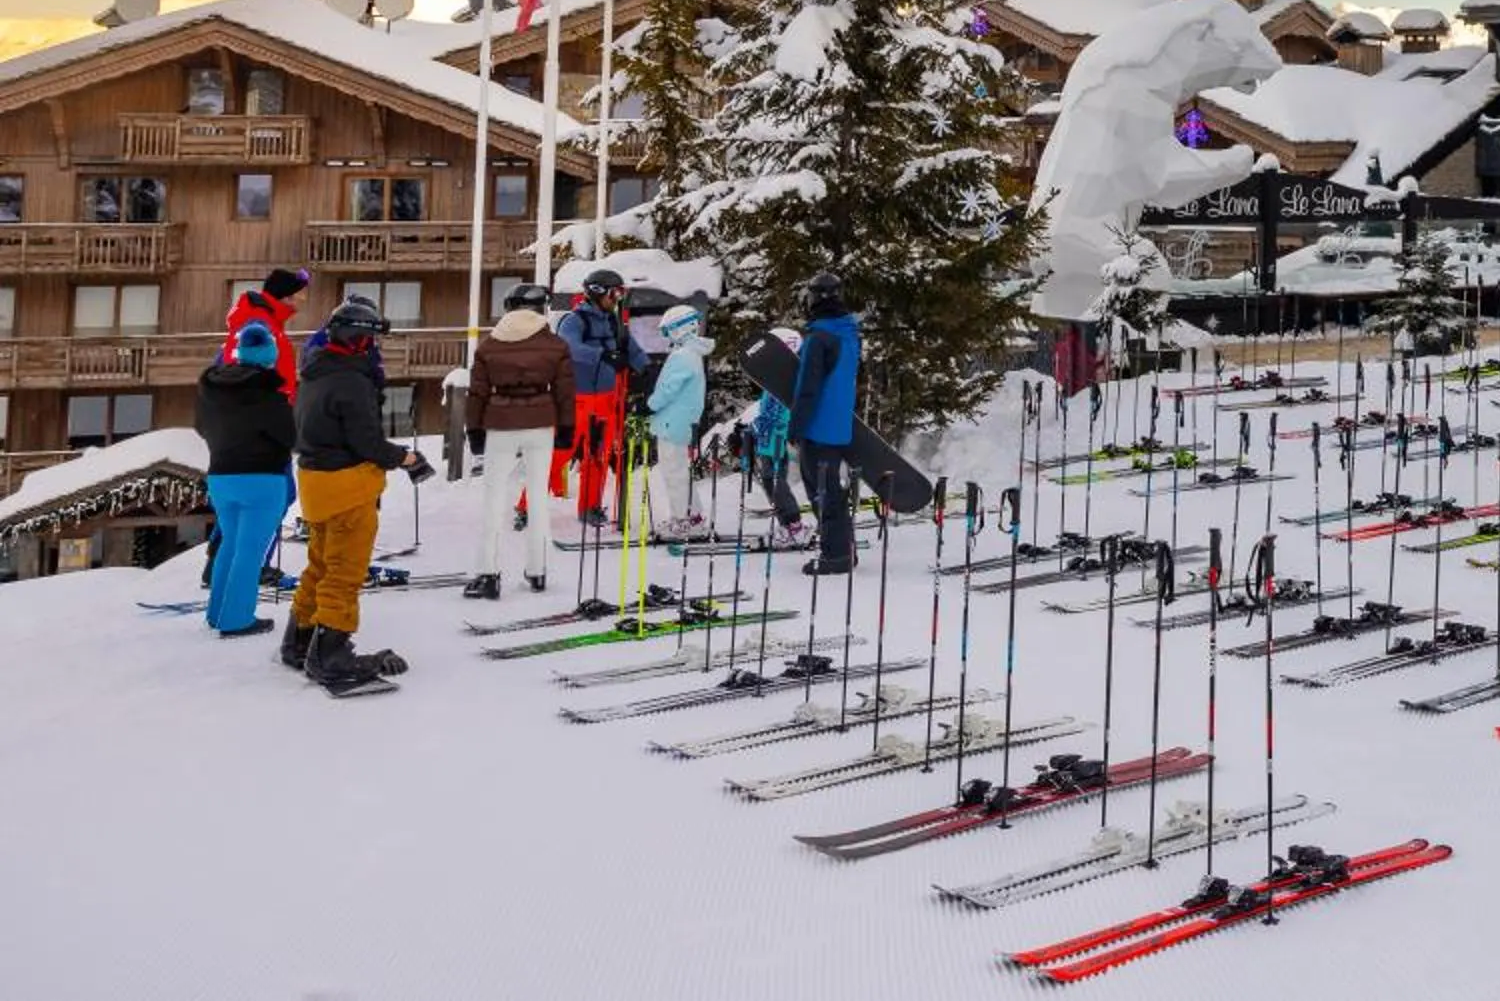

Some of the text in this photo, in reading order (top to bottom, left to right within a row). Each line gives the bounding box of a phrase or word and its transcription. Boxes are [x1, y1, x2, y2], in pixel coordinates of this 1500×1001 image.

[1206, 186, 1259, 218] Lana
[1280, 184, 1361, 217] Le Lana
